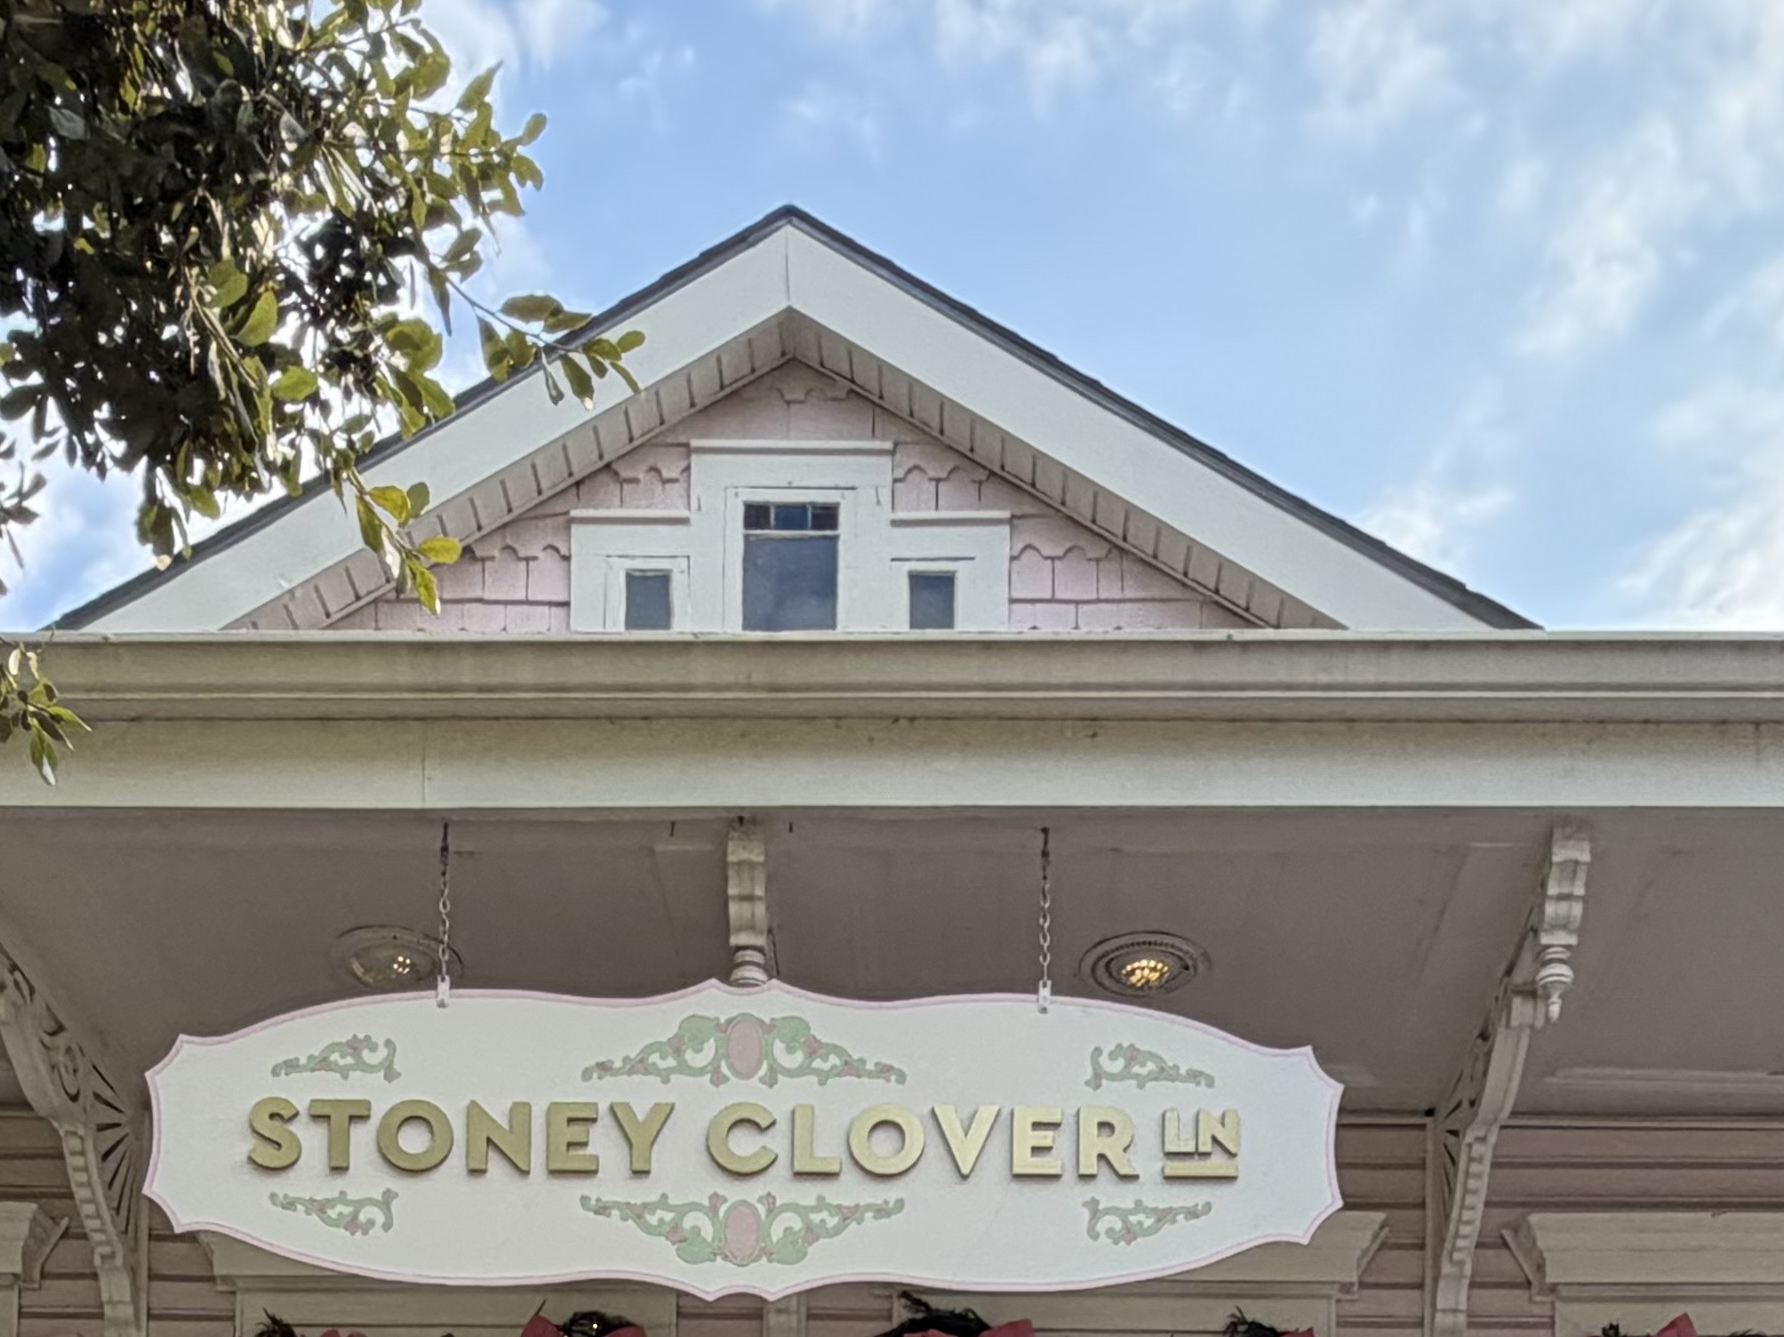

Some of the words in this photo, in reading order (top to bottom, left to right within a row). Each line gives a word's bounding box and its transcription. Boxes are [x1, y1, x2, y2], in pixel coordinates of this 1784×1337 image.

[247, 1096, 675, 1175] STONEY
[707, 1102, 1140, 1181] CLOVER
[1161, 1108, 1241, 1182] LN
